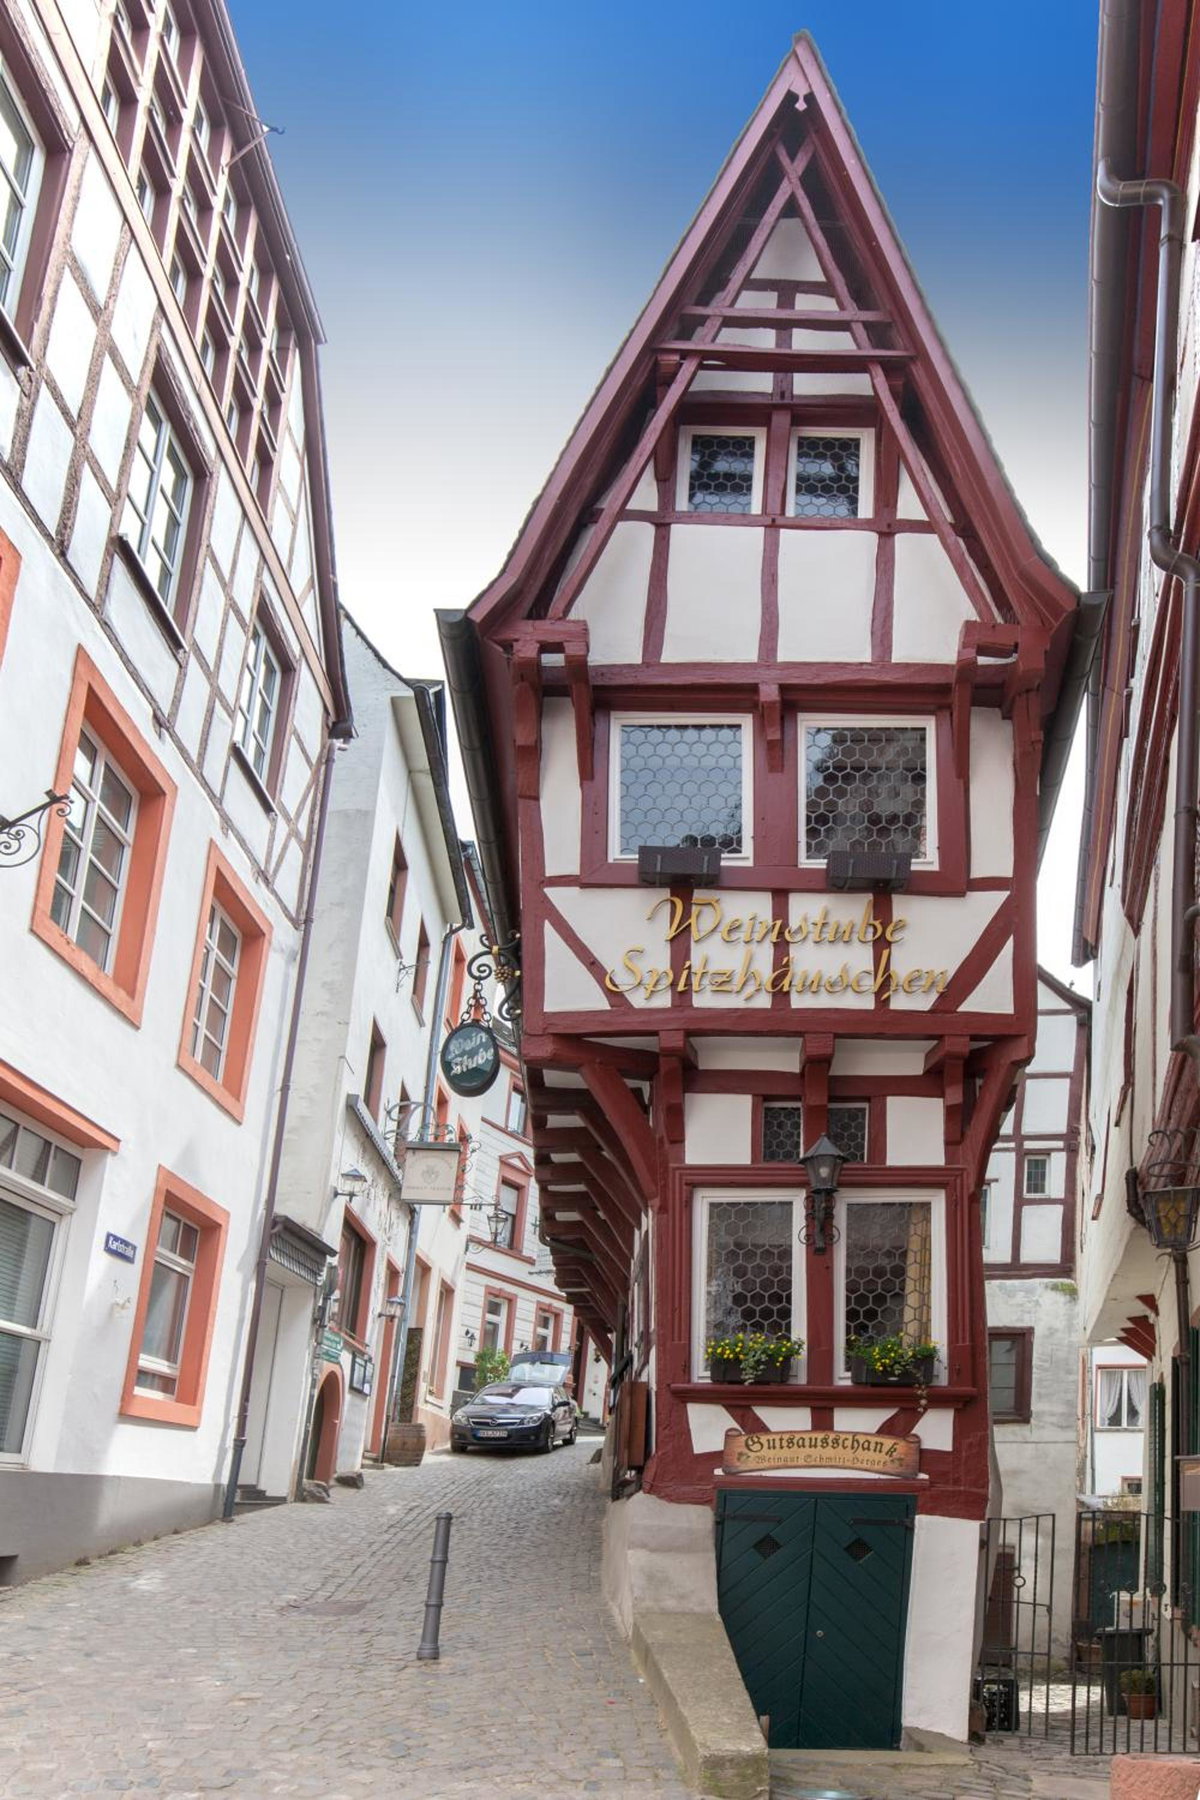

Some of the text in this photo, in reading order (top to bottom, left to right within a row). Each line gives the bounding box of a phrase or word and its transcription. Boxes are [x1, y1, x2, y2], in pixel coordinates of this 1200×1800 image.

[646, 895, 908, 944] Weinstube
[604, 945, 948, 1001] Spitzhäuschen
[450, 1047, 494, 1077] Stube
[744, 1433, 898, 1458] Gutsausschank
[755, 1454, 800, 1464] Weingut
